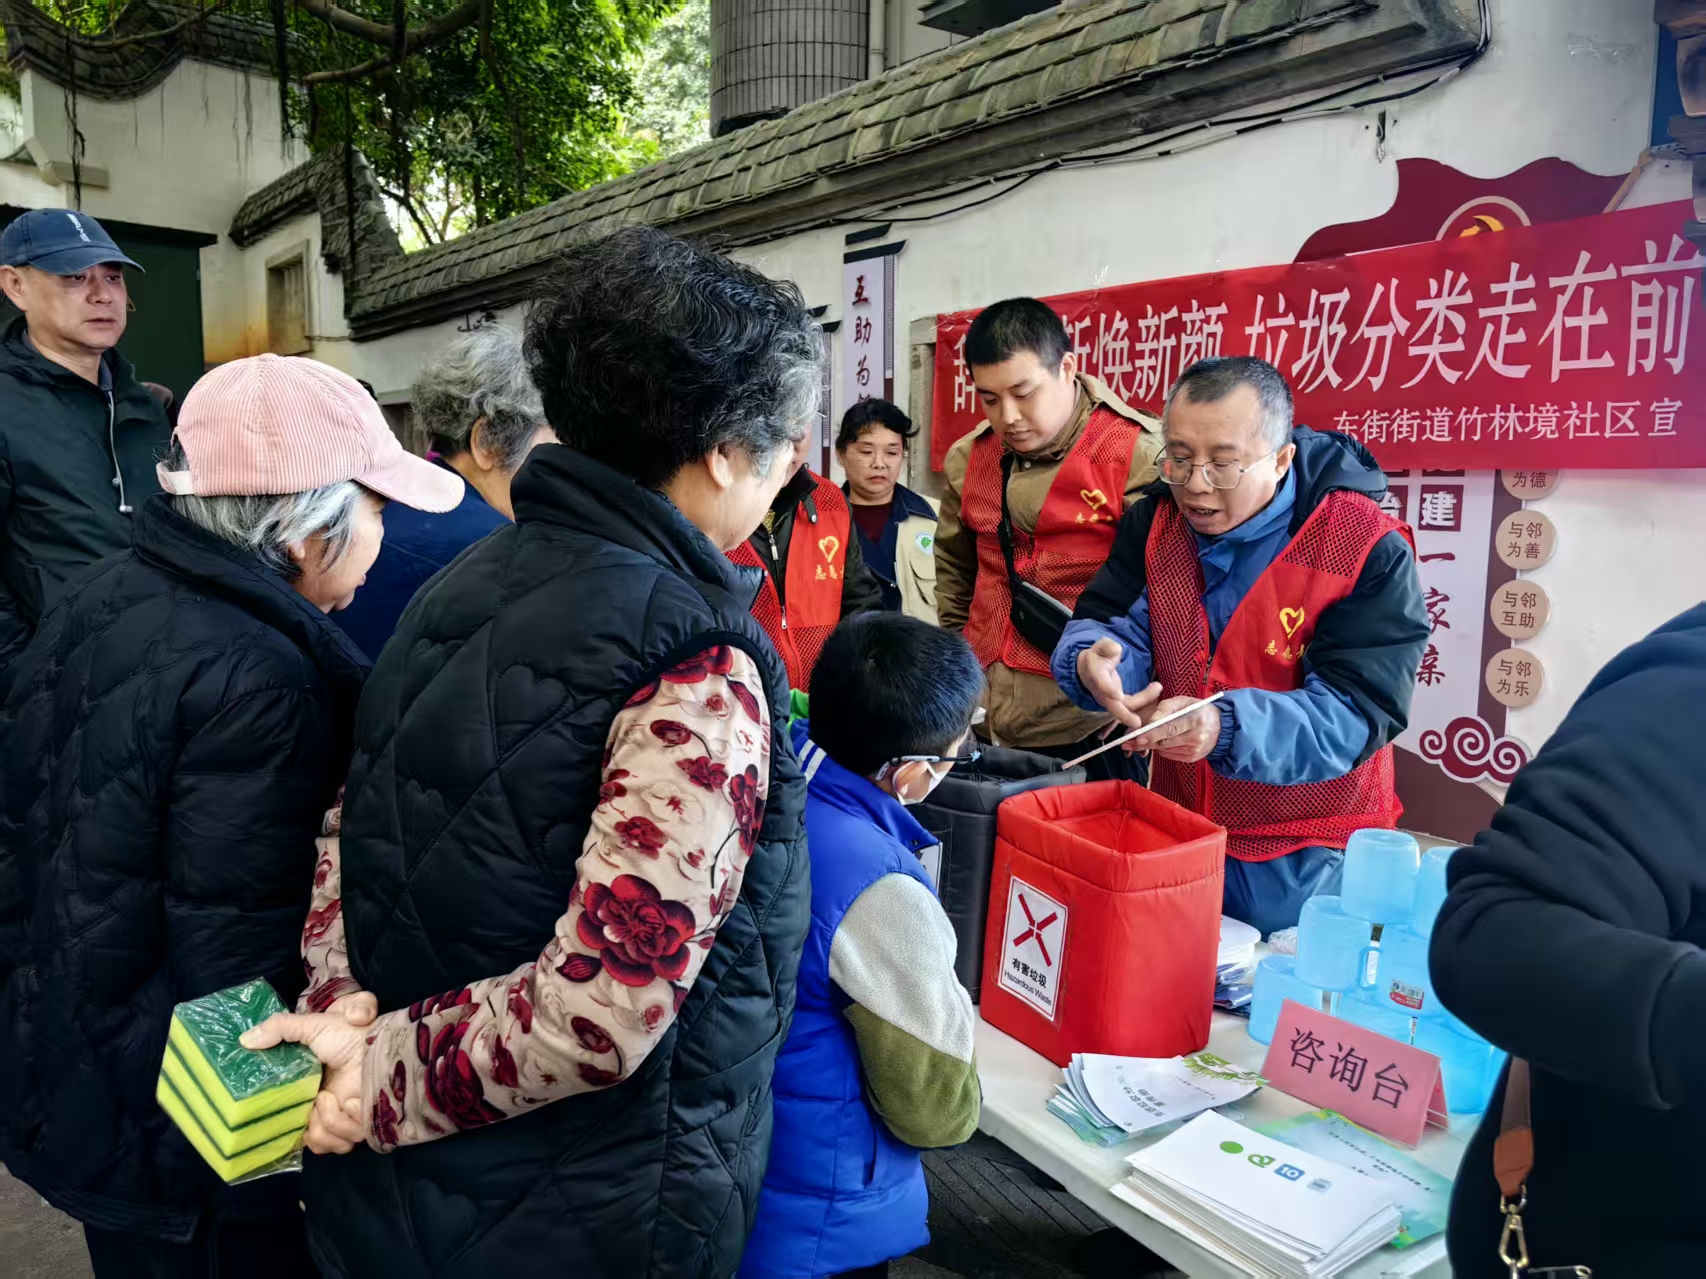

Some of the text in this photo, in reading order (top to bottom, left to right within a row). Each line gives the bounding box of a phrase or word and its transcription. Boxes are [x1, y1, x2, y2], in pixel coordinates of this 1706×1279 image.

[1244, 233, 1702, 394] 垃圾分类走在前
[852, 274, 873, 403] 互助为
[1512, 471, 1547, 488] 为德
[1508, 521, 1543, 539] 与邻
[1506, 542, 1541, 559] 为善
[1502, 590, 1537, 609] 与邻
[1501, 611, 1535, 629] 互助
[1497, 658, 1532, 678] 与邻
[1496, 679, 1530, 697] 为乐
[1012, 957, 1047, 988] 有害垃圾
[1004, 970, 1052, 1006] Hazardous Waste
[1290, 1026, 1410, 1109] 咨询台
